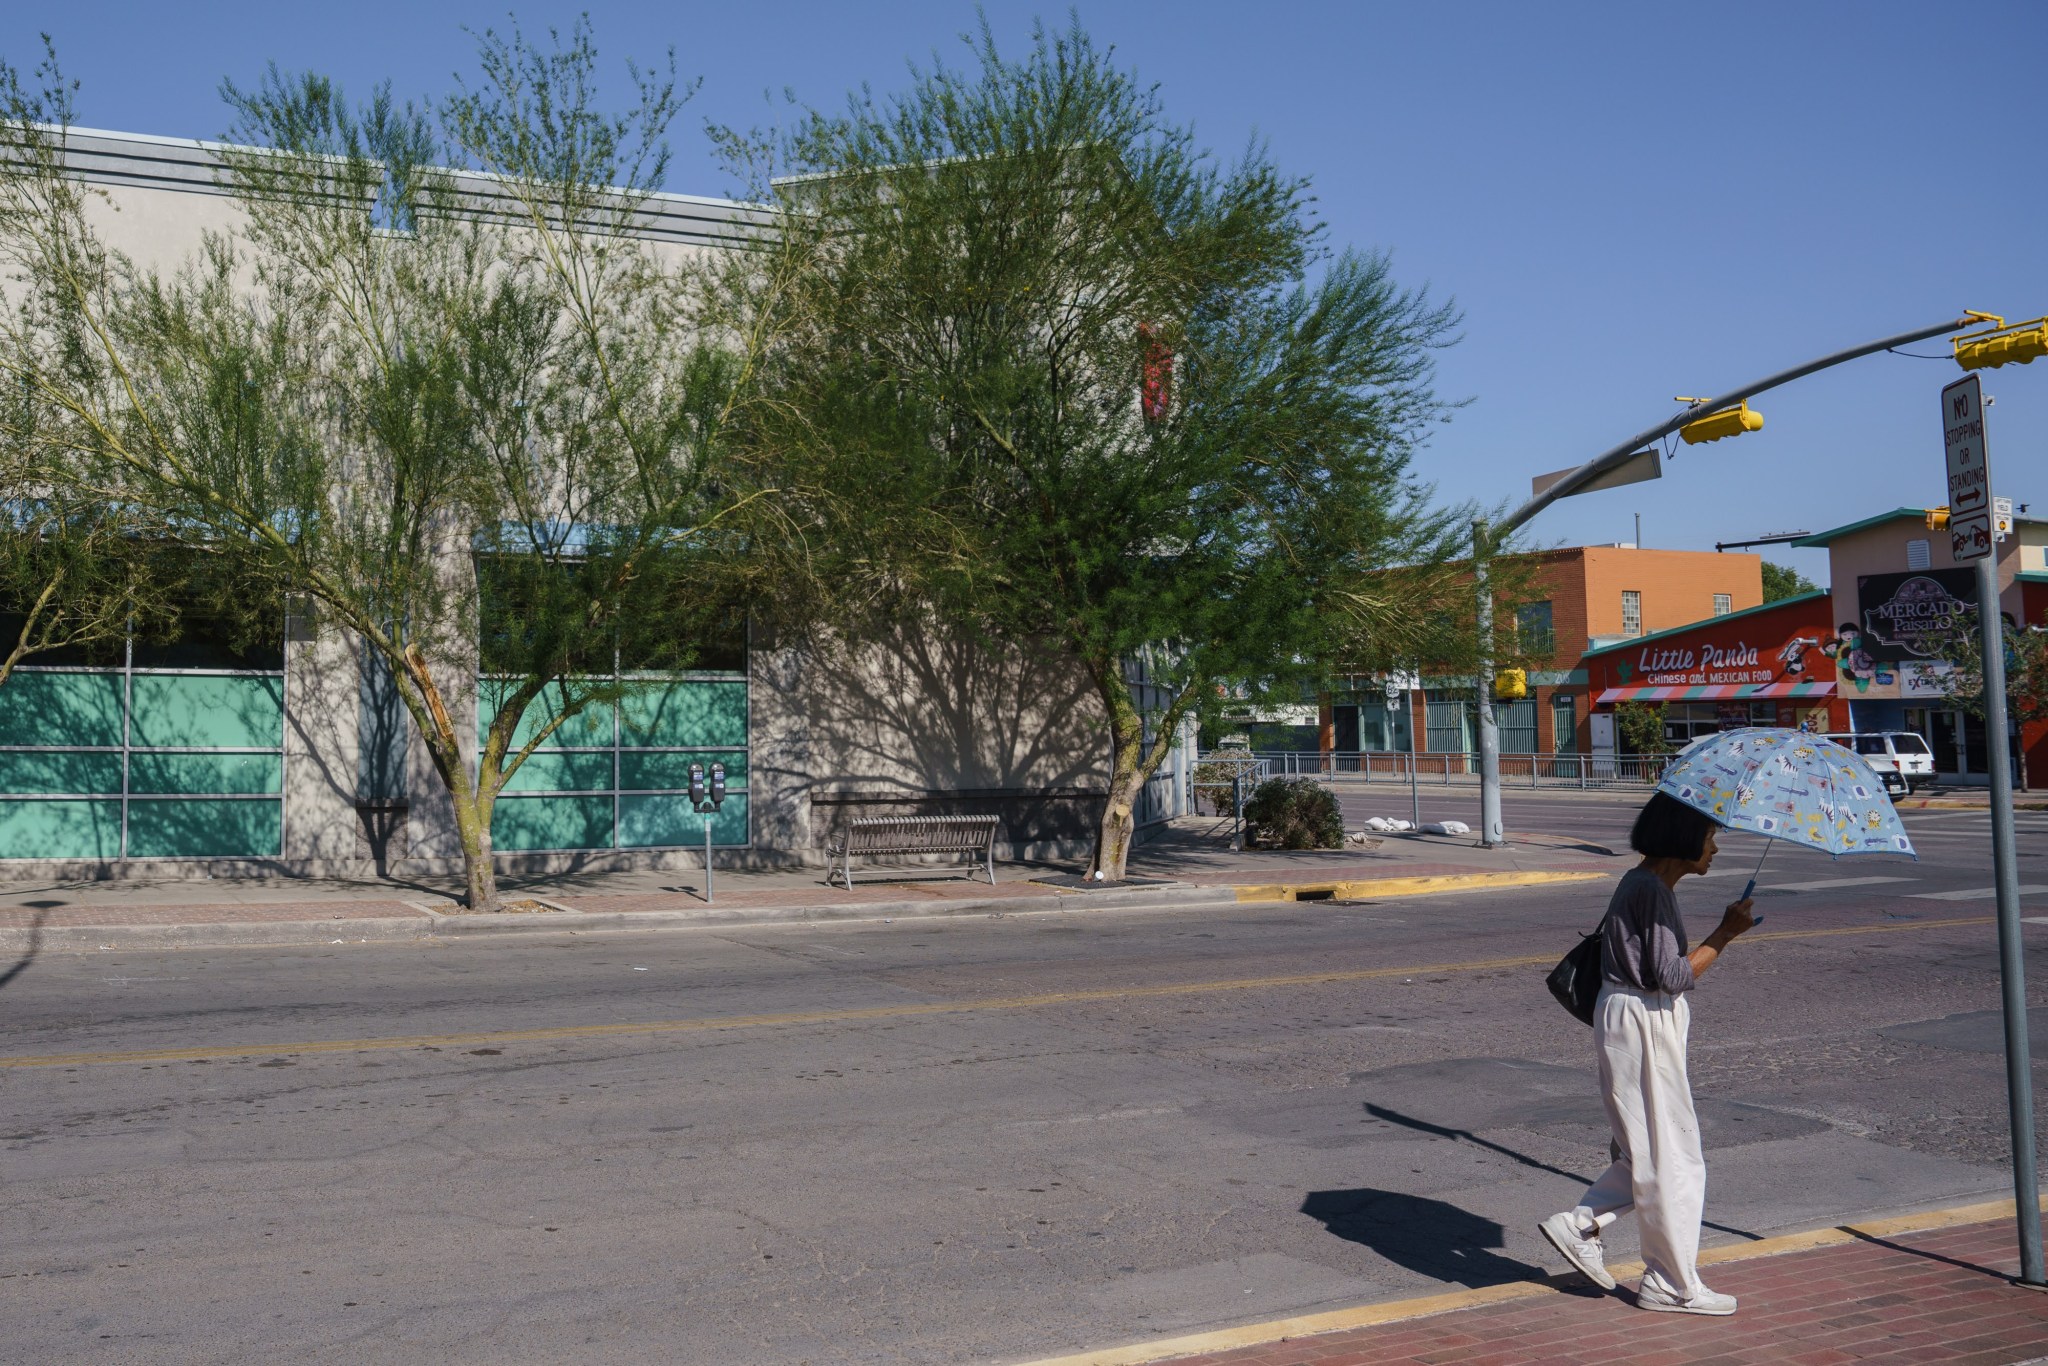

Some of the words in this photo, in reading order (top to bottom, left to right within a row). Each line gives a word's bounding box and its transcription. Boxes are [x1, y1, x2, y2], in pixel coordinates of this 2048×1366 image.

[1954, 394, 1968, 420] NO
[1947, 420, 1980, 446] STOPPING
[1960, 447, 1970, 465] OR
[1950, 466, 1984, 492] STANDING
[1879, 600, 1964, 618] MERCADO
[1639, 648, 1694, 671] Little
[1700, 642, 1758, 671] Panda
[1689, 671, 1707, 684] and
[1709, 671, 1750, 684] MEXICAN
[1752, 670, 1772, 682] FOOD
